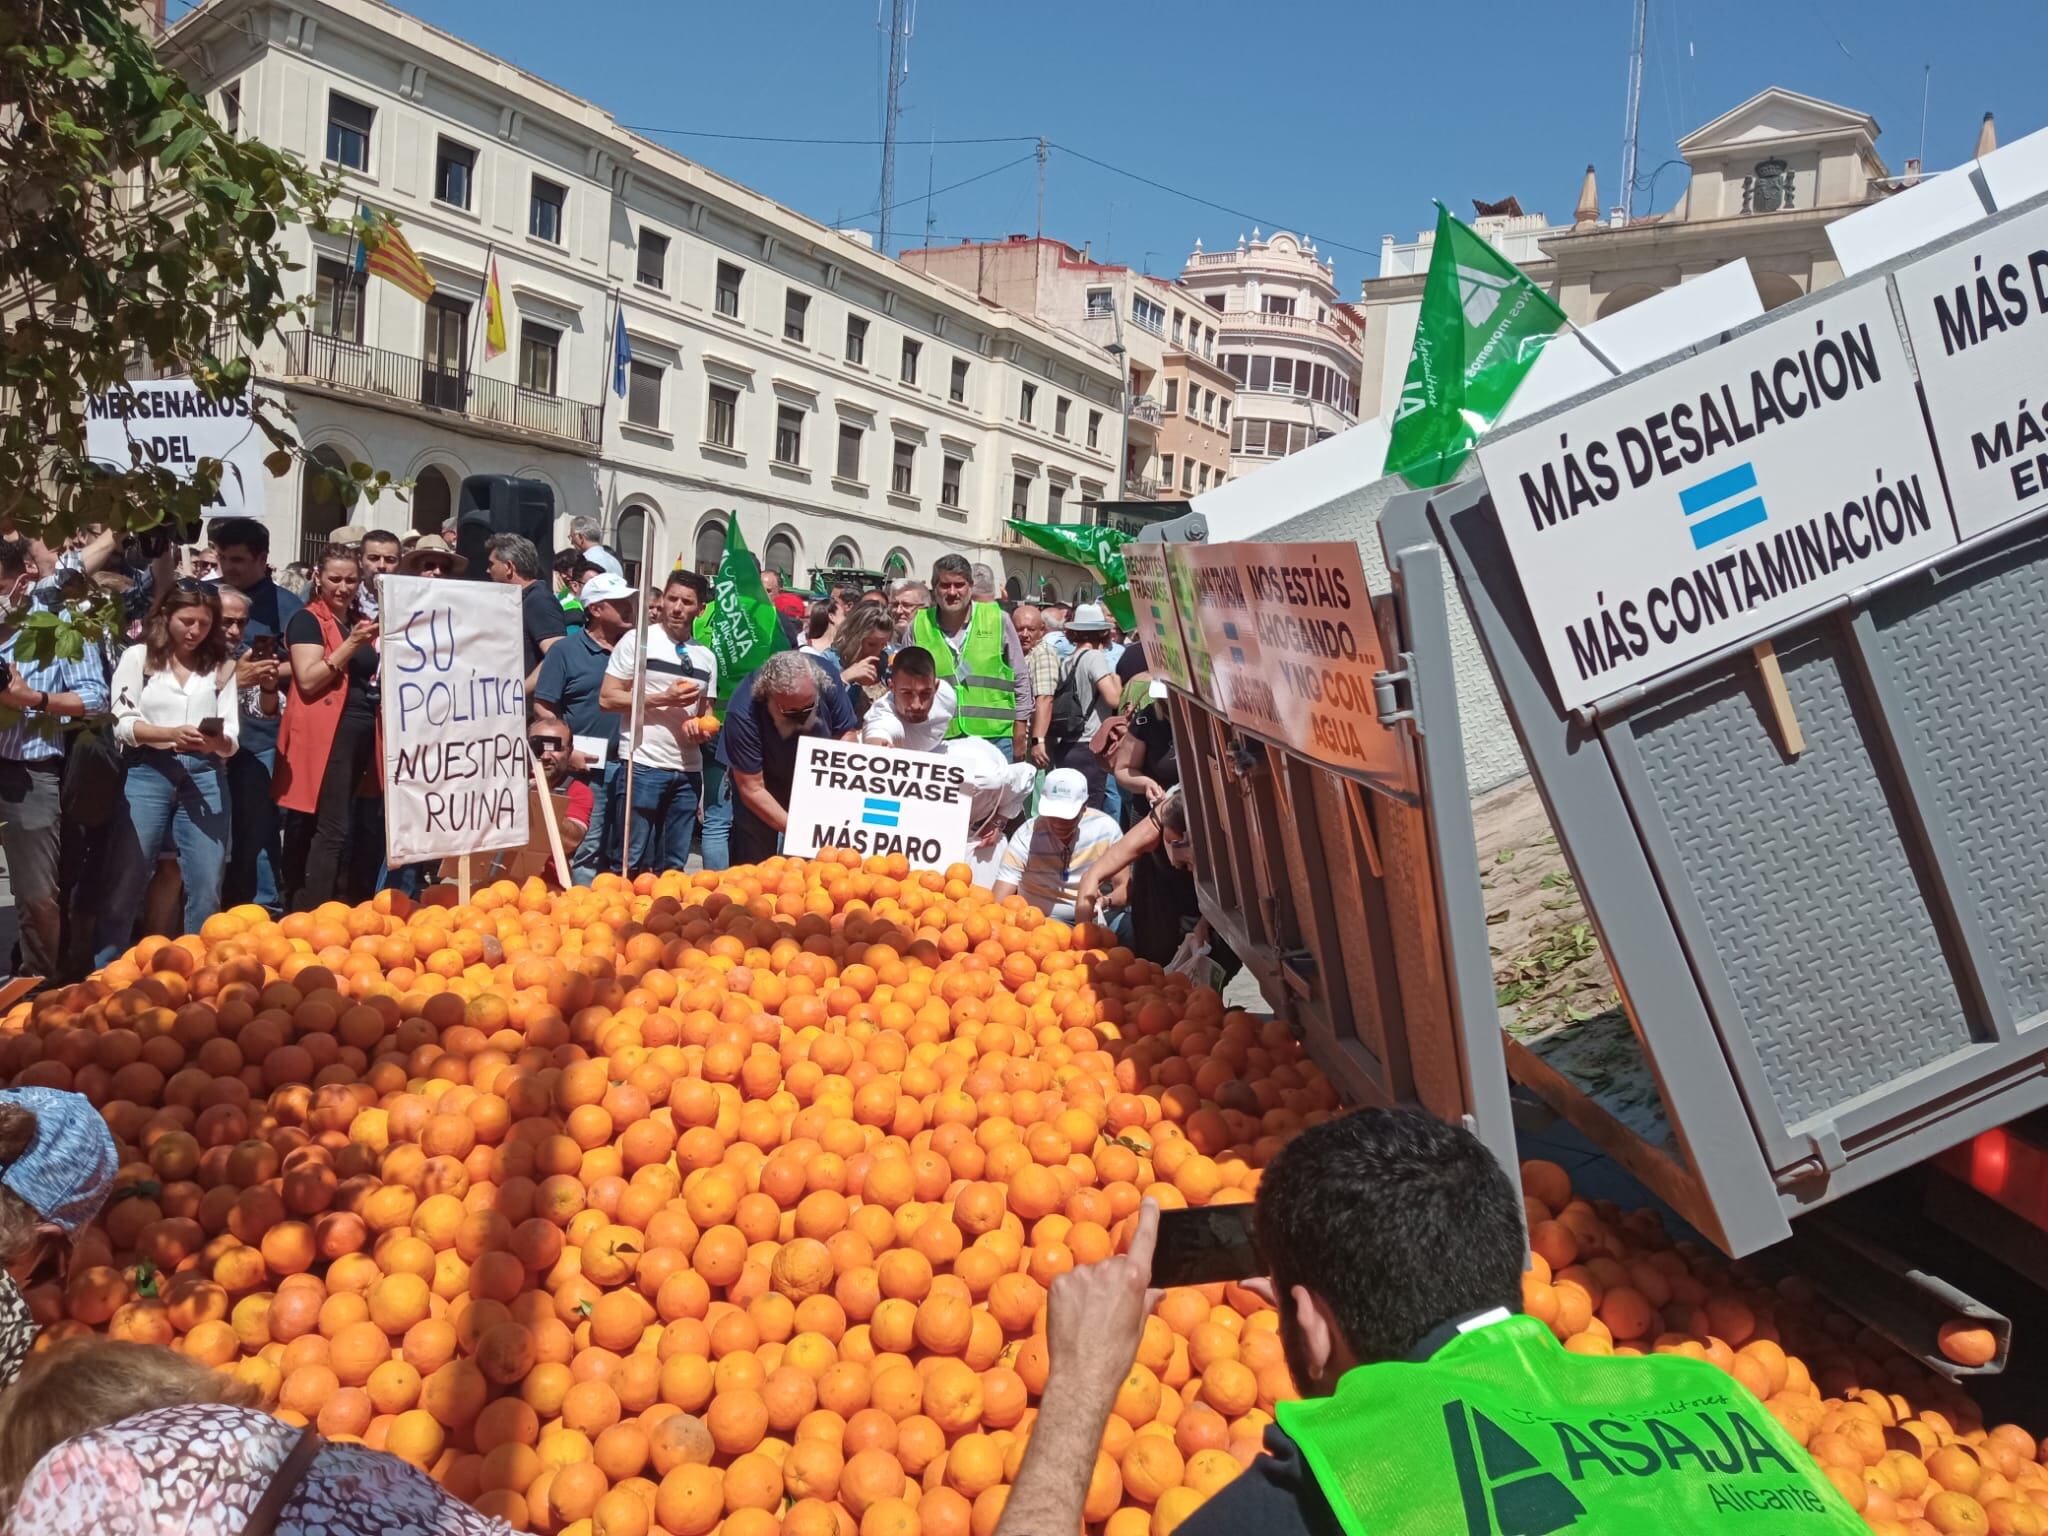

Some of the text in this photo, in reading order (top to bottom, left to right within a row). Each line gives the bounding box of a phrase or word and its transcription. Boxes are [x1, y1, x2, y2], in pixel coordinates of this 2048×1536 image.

[1933, 255, 2028, 356] MÁS
[152, 436, 196, 463] DEL
[1519, 320, 1882, 532] MÁS DESALACIÓN
[1246, 565, 1284, 604] NOS
[1280, 554, 1351, 609] ESTÁIS
[1565, 468, 1932, 681] MÁS CONTAMINACIÓN
[396, 606, 454, 673] SU
[716, 580, 752, 658] ASAJA
[1254, 611, 1376, 665] AHOGANDO...
[398, 668, 525, 732] POLÍTICA
[1279, 659, 1294, 696] Y
[1298, 662, 1322, 703] NO
[1320, 669, 1371, 716] CON
[394, 734, 526, 785] NUESTRA
[1311, 712, 1367, 762] AGUA
[810, 748, 965, 784] RECORTES
[810, 768, 960, 805] TRASVASE
[425, 787, 514, 833] RUINA
[811, 820, 942, 864] MÁS PARO
[1550, 1411, 1800, 1481] ASAJA
[1708, 1483, 1827, 1515] Alicante
